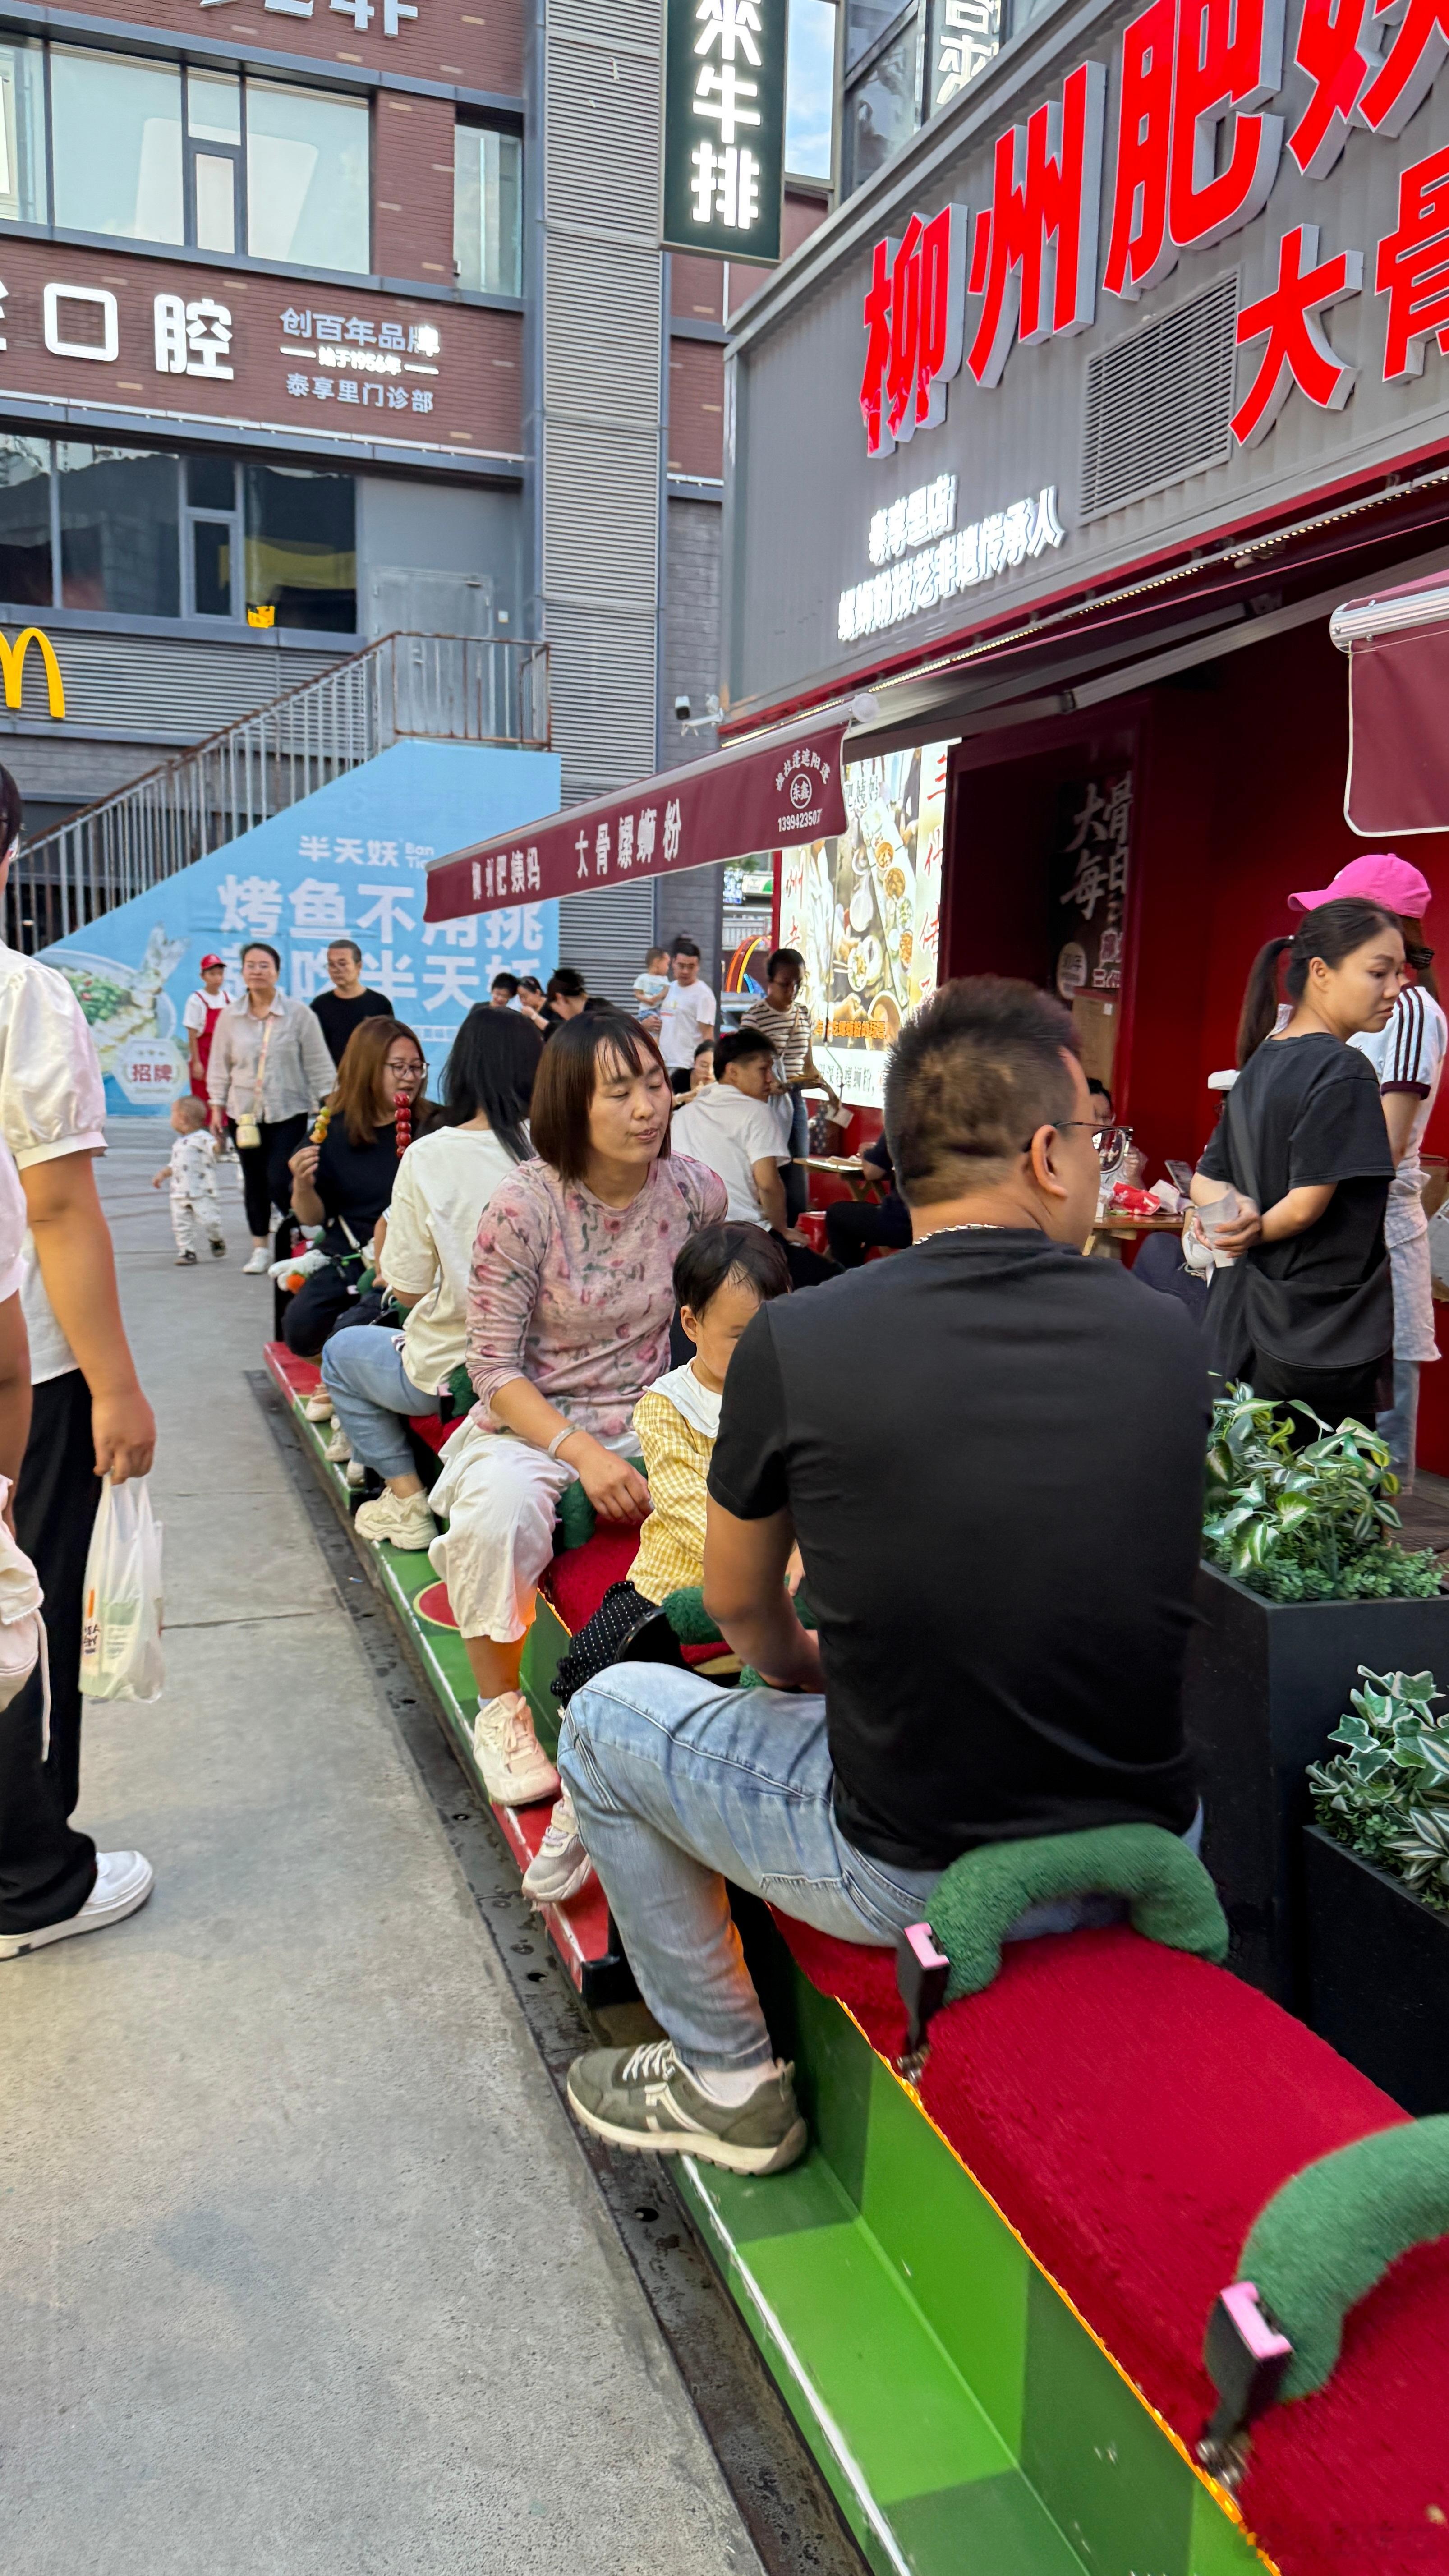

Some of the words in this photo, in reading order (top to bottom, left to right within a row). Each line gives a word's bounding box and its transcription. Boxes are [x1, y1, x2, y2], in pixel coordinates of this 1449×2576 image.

[0, 281, 234, 380] 口腔
[279, 307, 440, 357] 创百年品牌
[286, 373, 434, 413] 泰享里门诊部
[298, 835, 400, 868] 半天妖
[405, 842, 435, 856] Ban
[575, 798, 682, 879] 大骨螺蛳粉
[132, 1063, 172, 1082] 招牌
